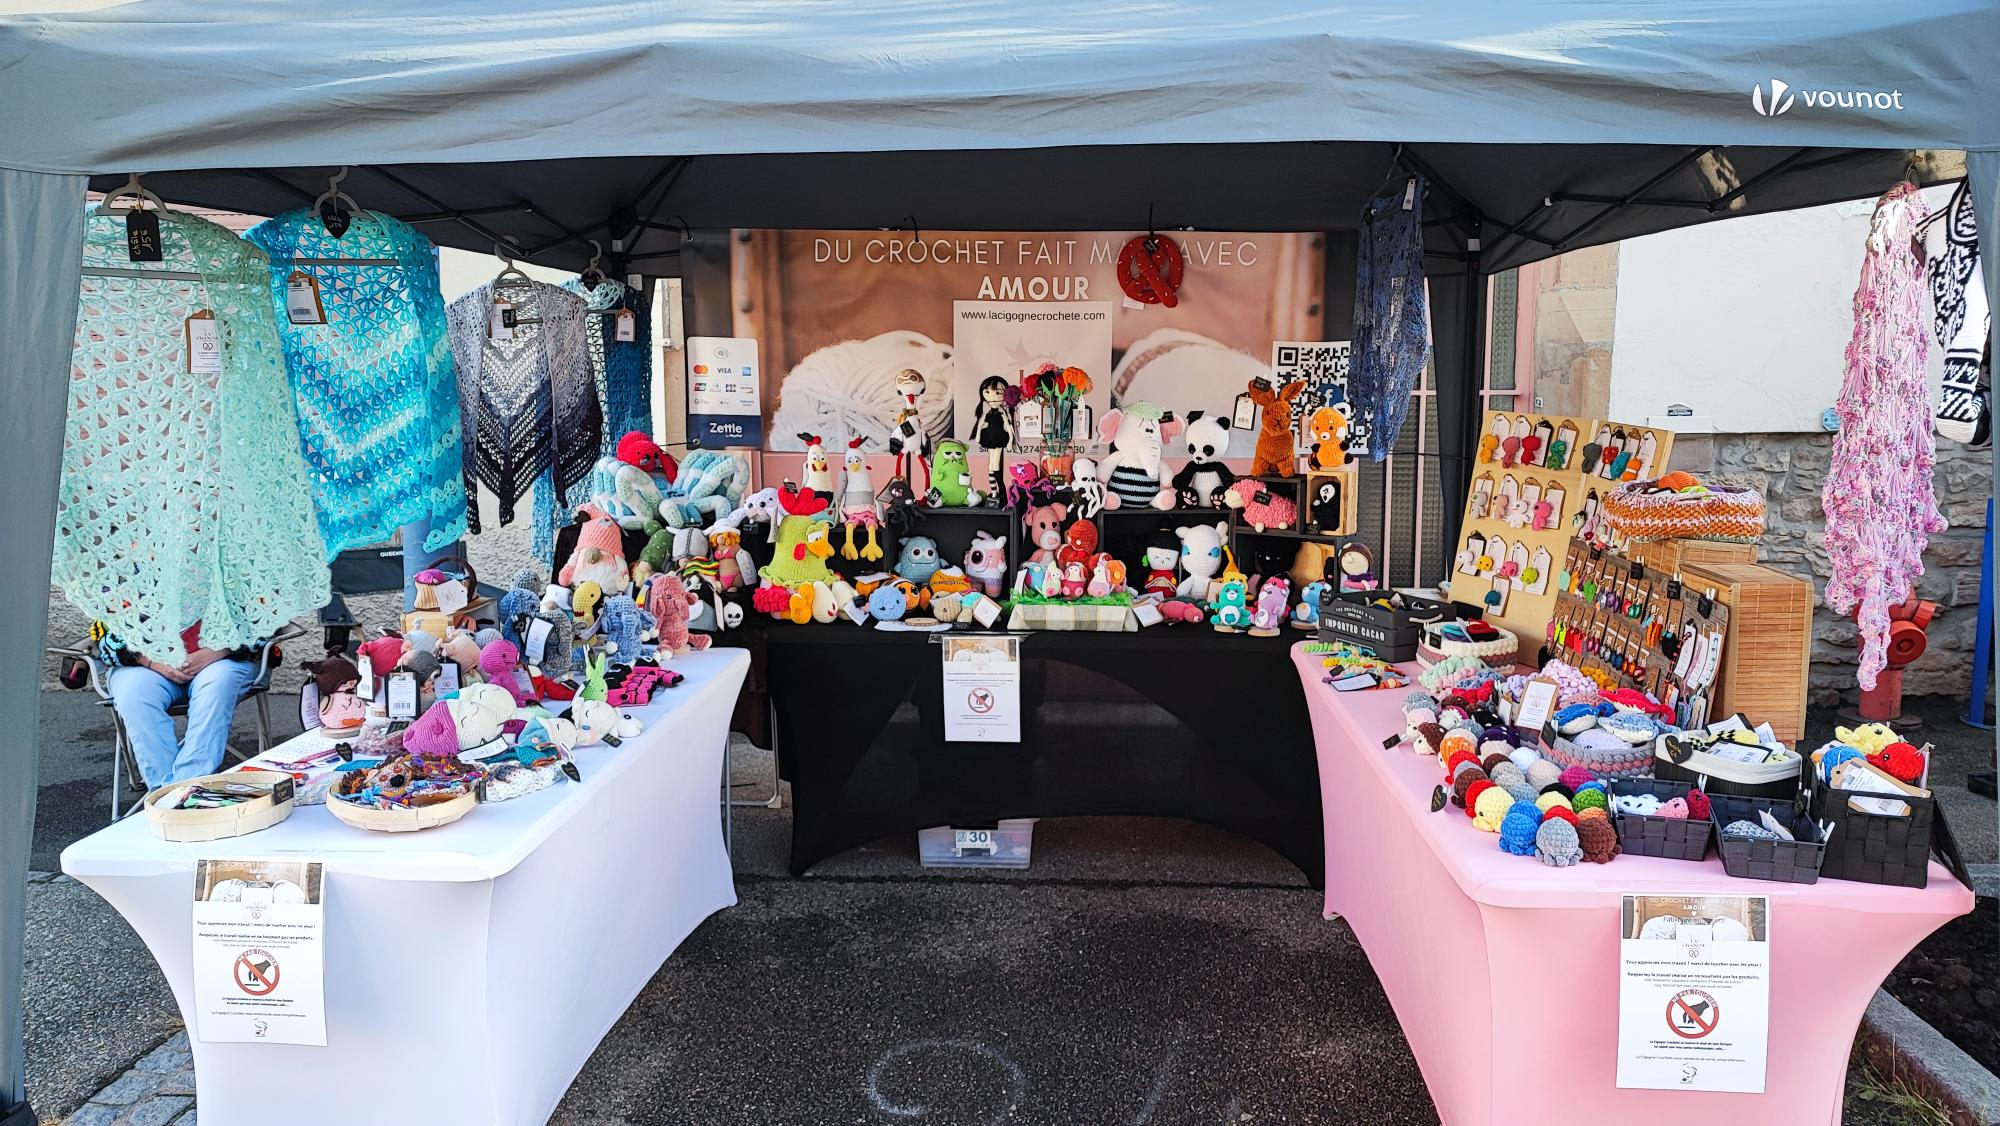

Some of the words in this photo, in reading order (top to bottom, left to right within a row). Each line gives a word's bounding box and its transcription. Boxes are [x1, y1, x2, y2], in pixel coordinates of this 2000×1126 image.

[1802, 89, 1904, 109] vounot
[814, 238, 851, 263] DU
[865, 239, 1004, 265] CROCHET
[1018, 240, 1076, 265] FAIT
[1181, 240, 1258, 266] AVEC
[977, 275, 1090, 301] AMOUR
[961, 310, 1106, 323] www.lacigognecrochete.com
[709, 422, 743, 433] Zettle
[379, 550, 404, 558] QUECHU
[1325, 618, 1358, 634] IMPORTED
[1361, 627, 1385, 641] CACAO
[969, 831, 988, 843] 30
